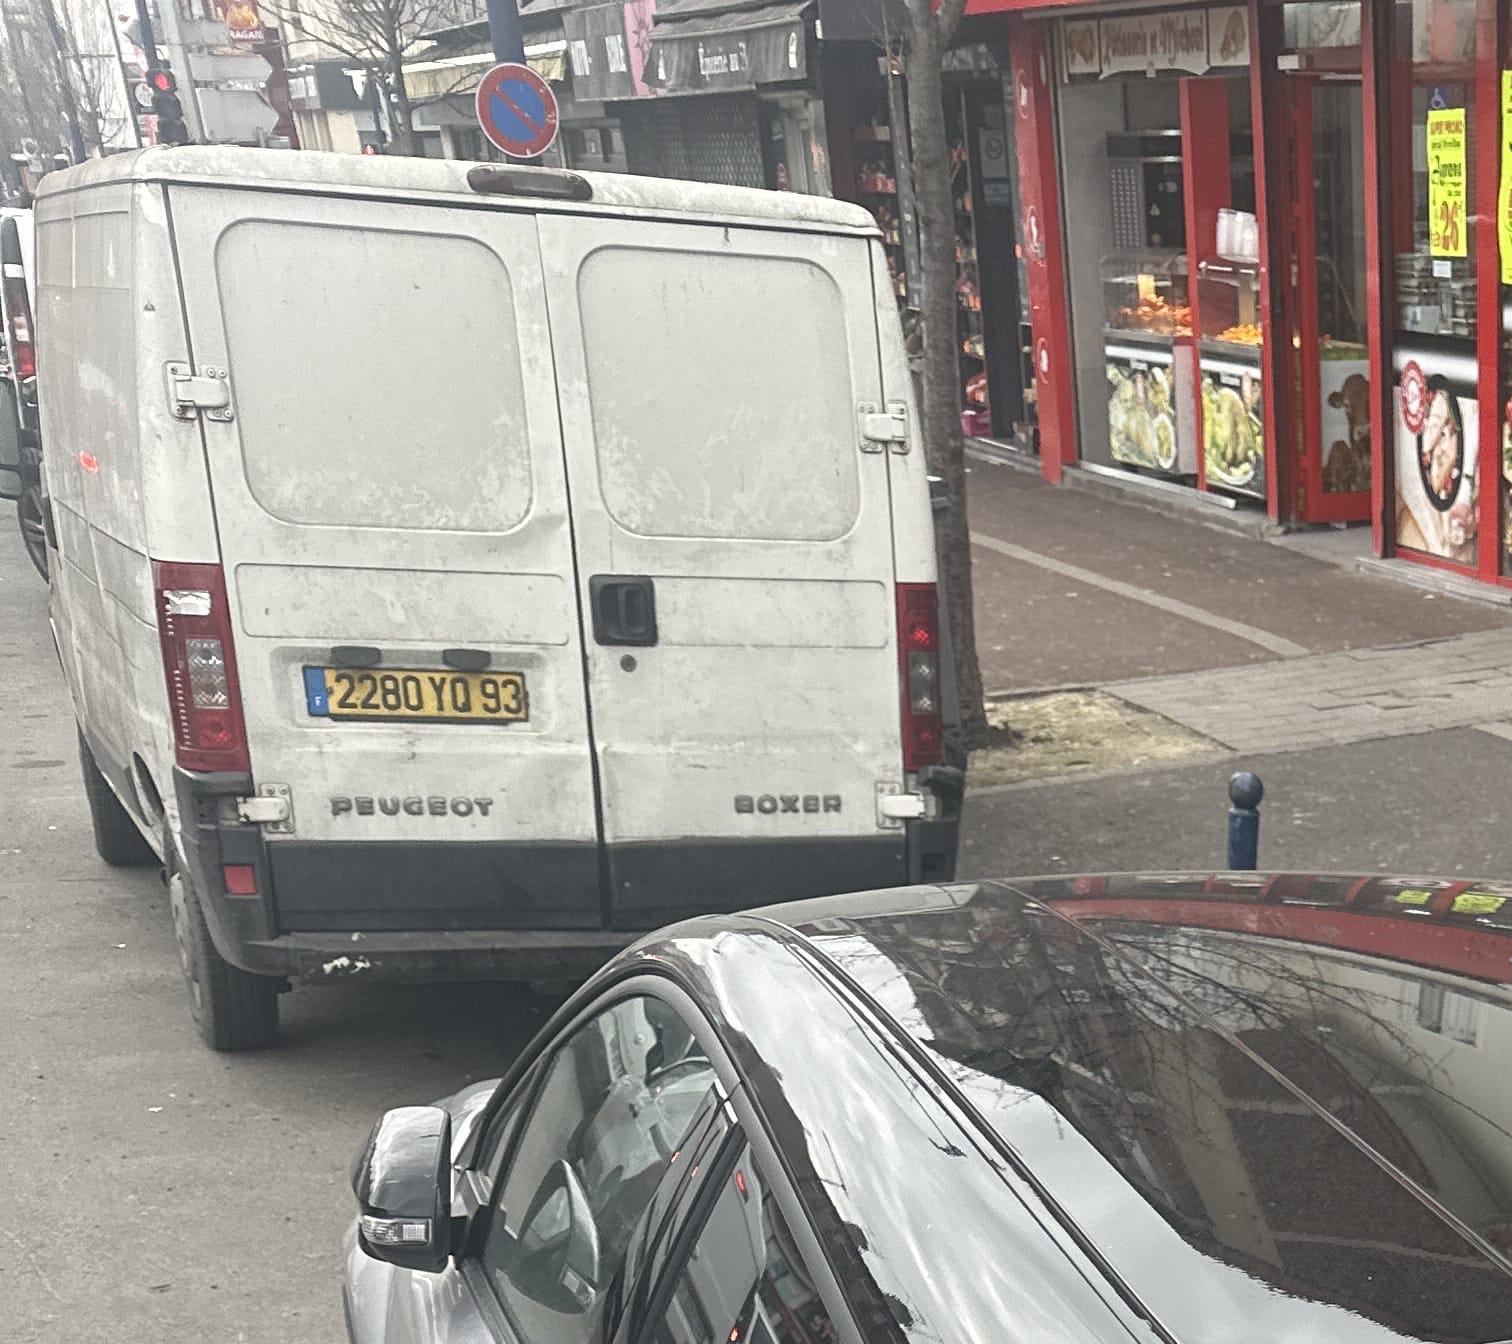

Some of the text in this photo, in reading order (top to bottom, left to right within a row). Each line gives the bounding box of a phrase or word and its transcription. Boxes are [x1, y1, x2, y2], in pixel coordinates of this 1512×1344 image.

[315, 673, 523, 715] F 2280 YQ 93
[330, 796, 494, 818] PEUGEOT
[734, 794, 842, 815] BOXER
